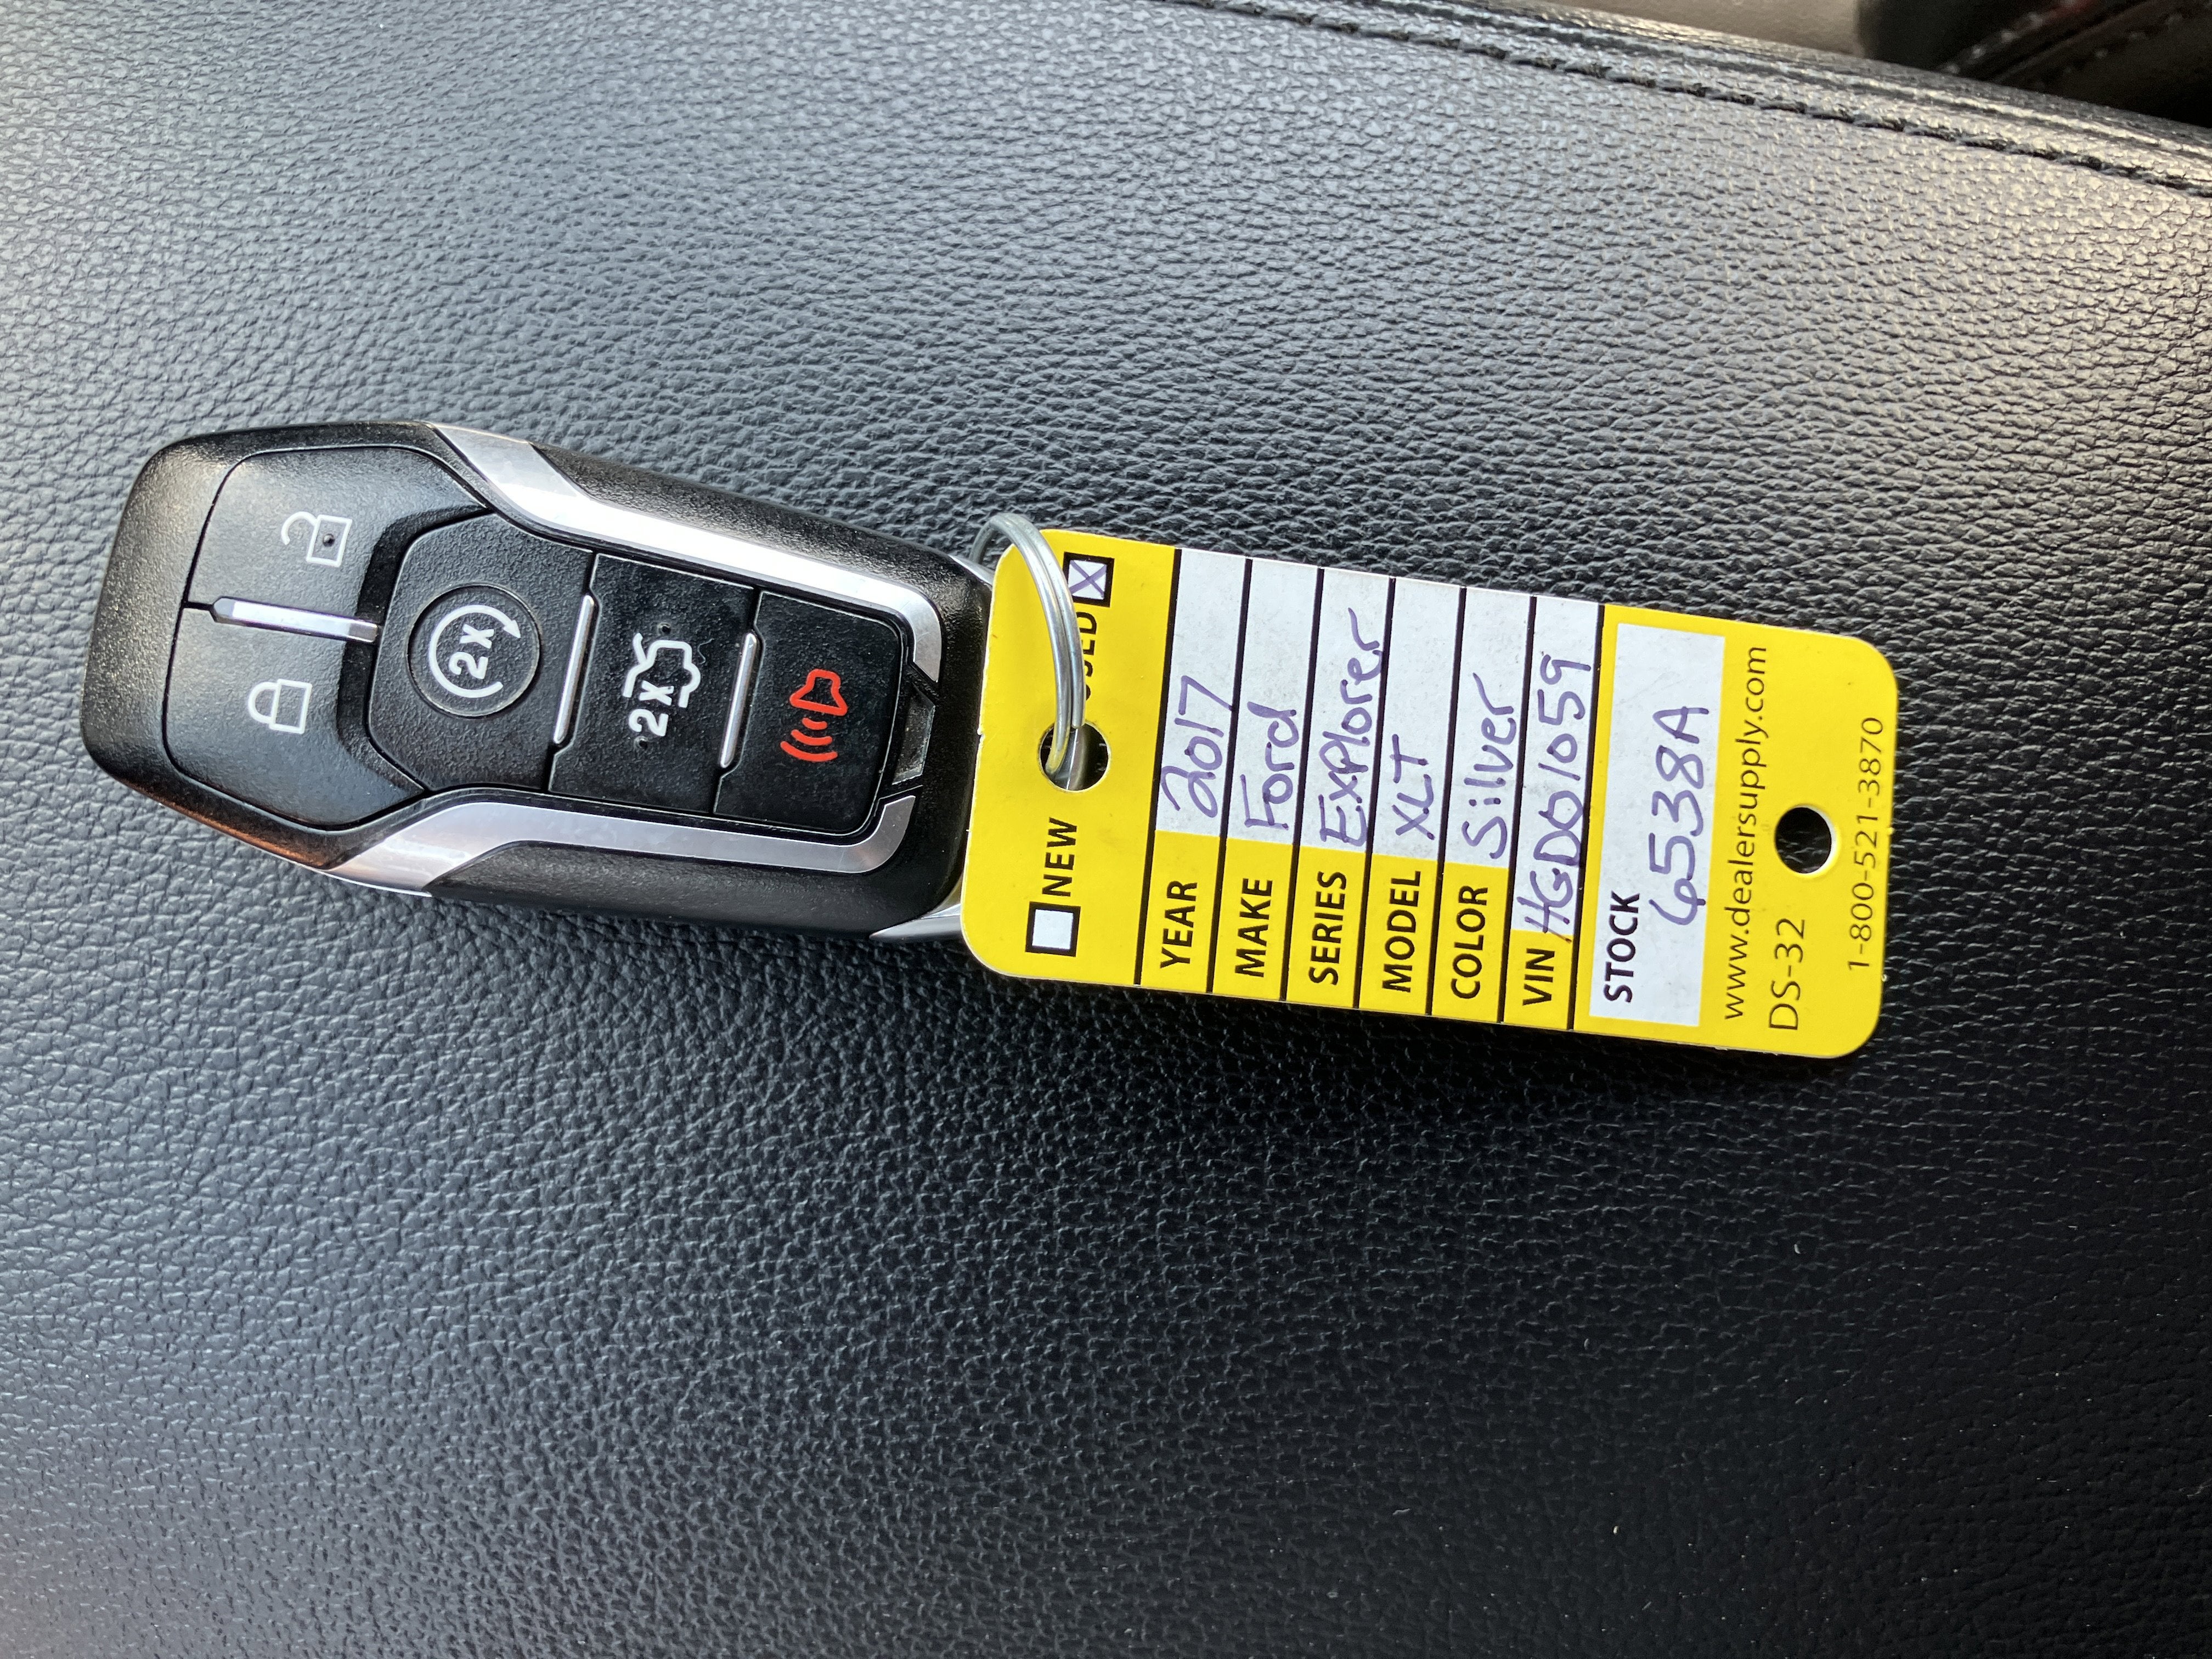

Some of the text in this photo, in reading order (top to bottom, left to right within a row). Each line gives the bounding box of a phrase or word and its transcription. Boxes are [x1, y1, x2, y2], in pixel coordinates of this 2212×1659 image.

[1160, 675, 1234, 819] 2017
[1241, 702, 1300, 831] Ford
[1390, 733, 1435, 840] XLT
[1462, 672, 1516, 860] Silver
[1042, 817, 1077, 898] NEW
[1649, 707, 1709, 926] 6538A
[1725, 646, 1768, 1020] www.dealersupply.com
[1848, 716, 1884, 972] 1-800-521-3870
[1160, 880, 1198, 969] YEAR
[1235, 878, 1273, 978] MAKE
[1308, 871, 1347, 986] SERIES
[1382, 871, 1421, 994] MODEL
[1451, 885, 1488, 1000] COLOR
[1522, 948, 1555, 1006] VIN
[1603, 890, 1640, 1003] STOCK
[1769, 918, 1804, 1031] DS-32
